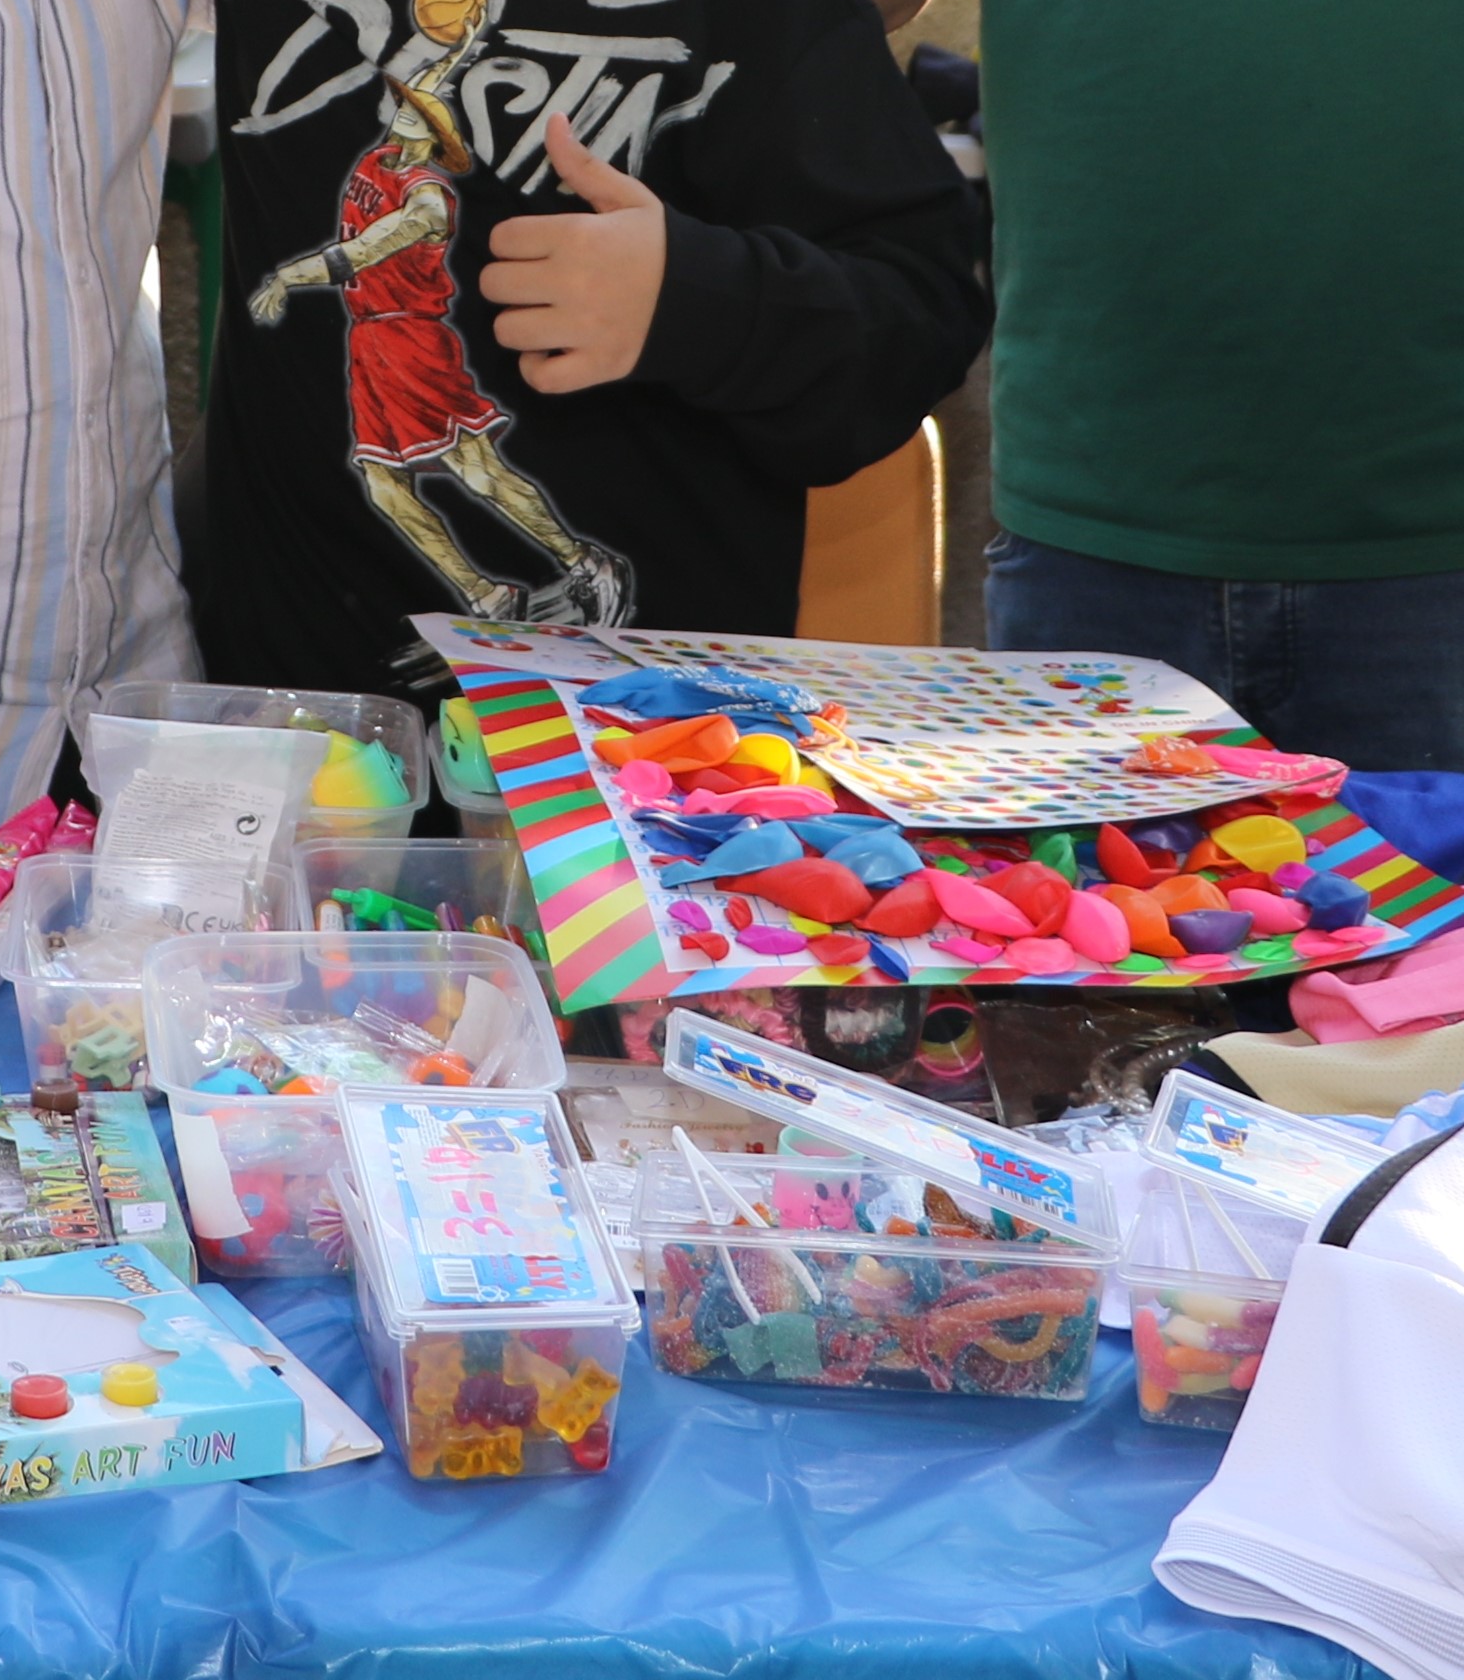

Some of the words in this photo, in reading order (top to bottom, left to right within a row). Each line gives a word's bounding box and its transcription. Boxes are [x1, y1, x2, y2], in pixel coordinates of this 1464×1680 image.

[37, 1151, 100, 1239] CANVAS
[98, 1163, 144, 1200] ART
[70, 1443, 148, 1485] ART
[163, 1429, 237, 1472] FUN
